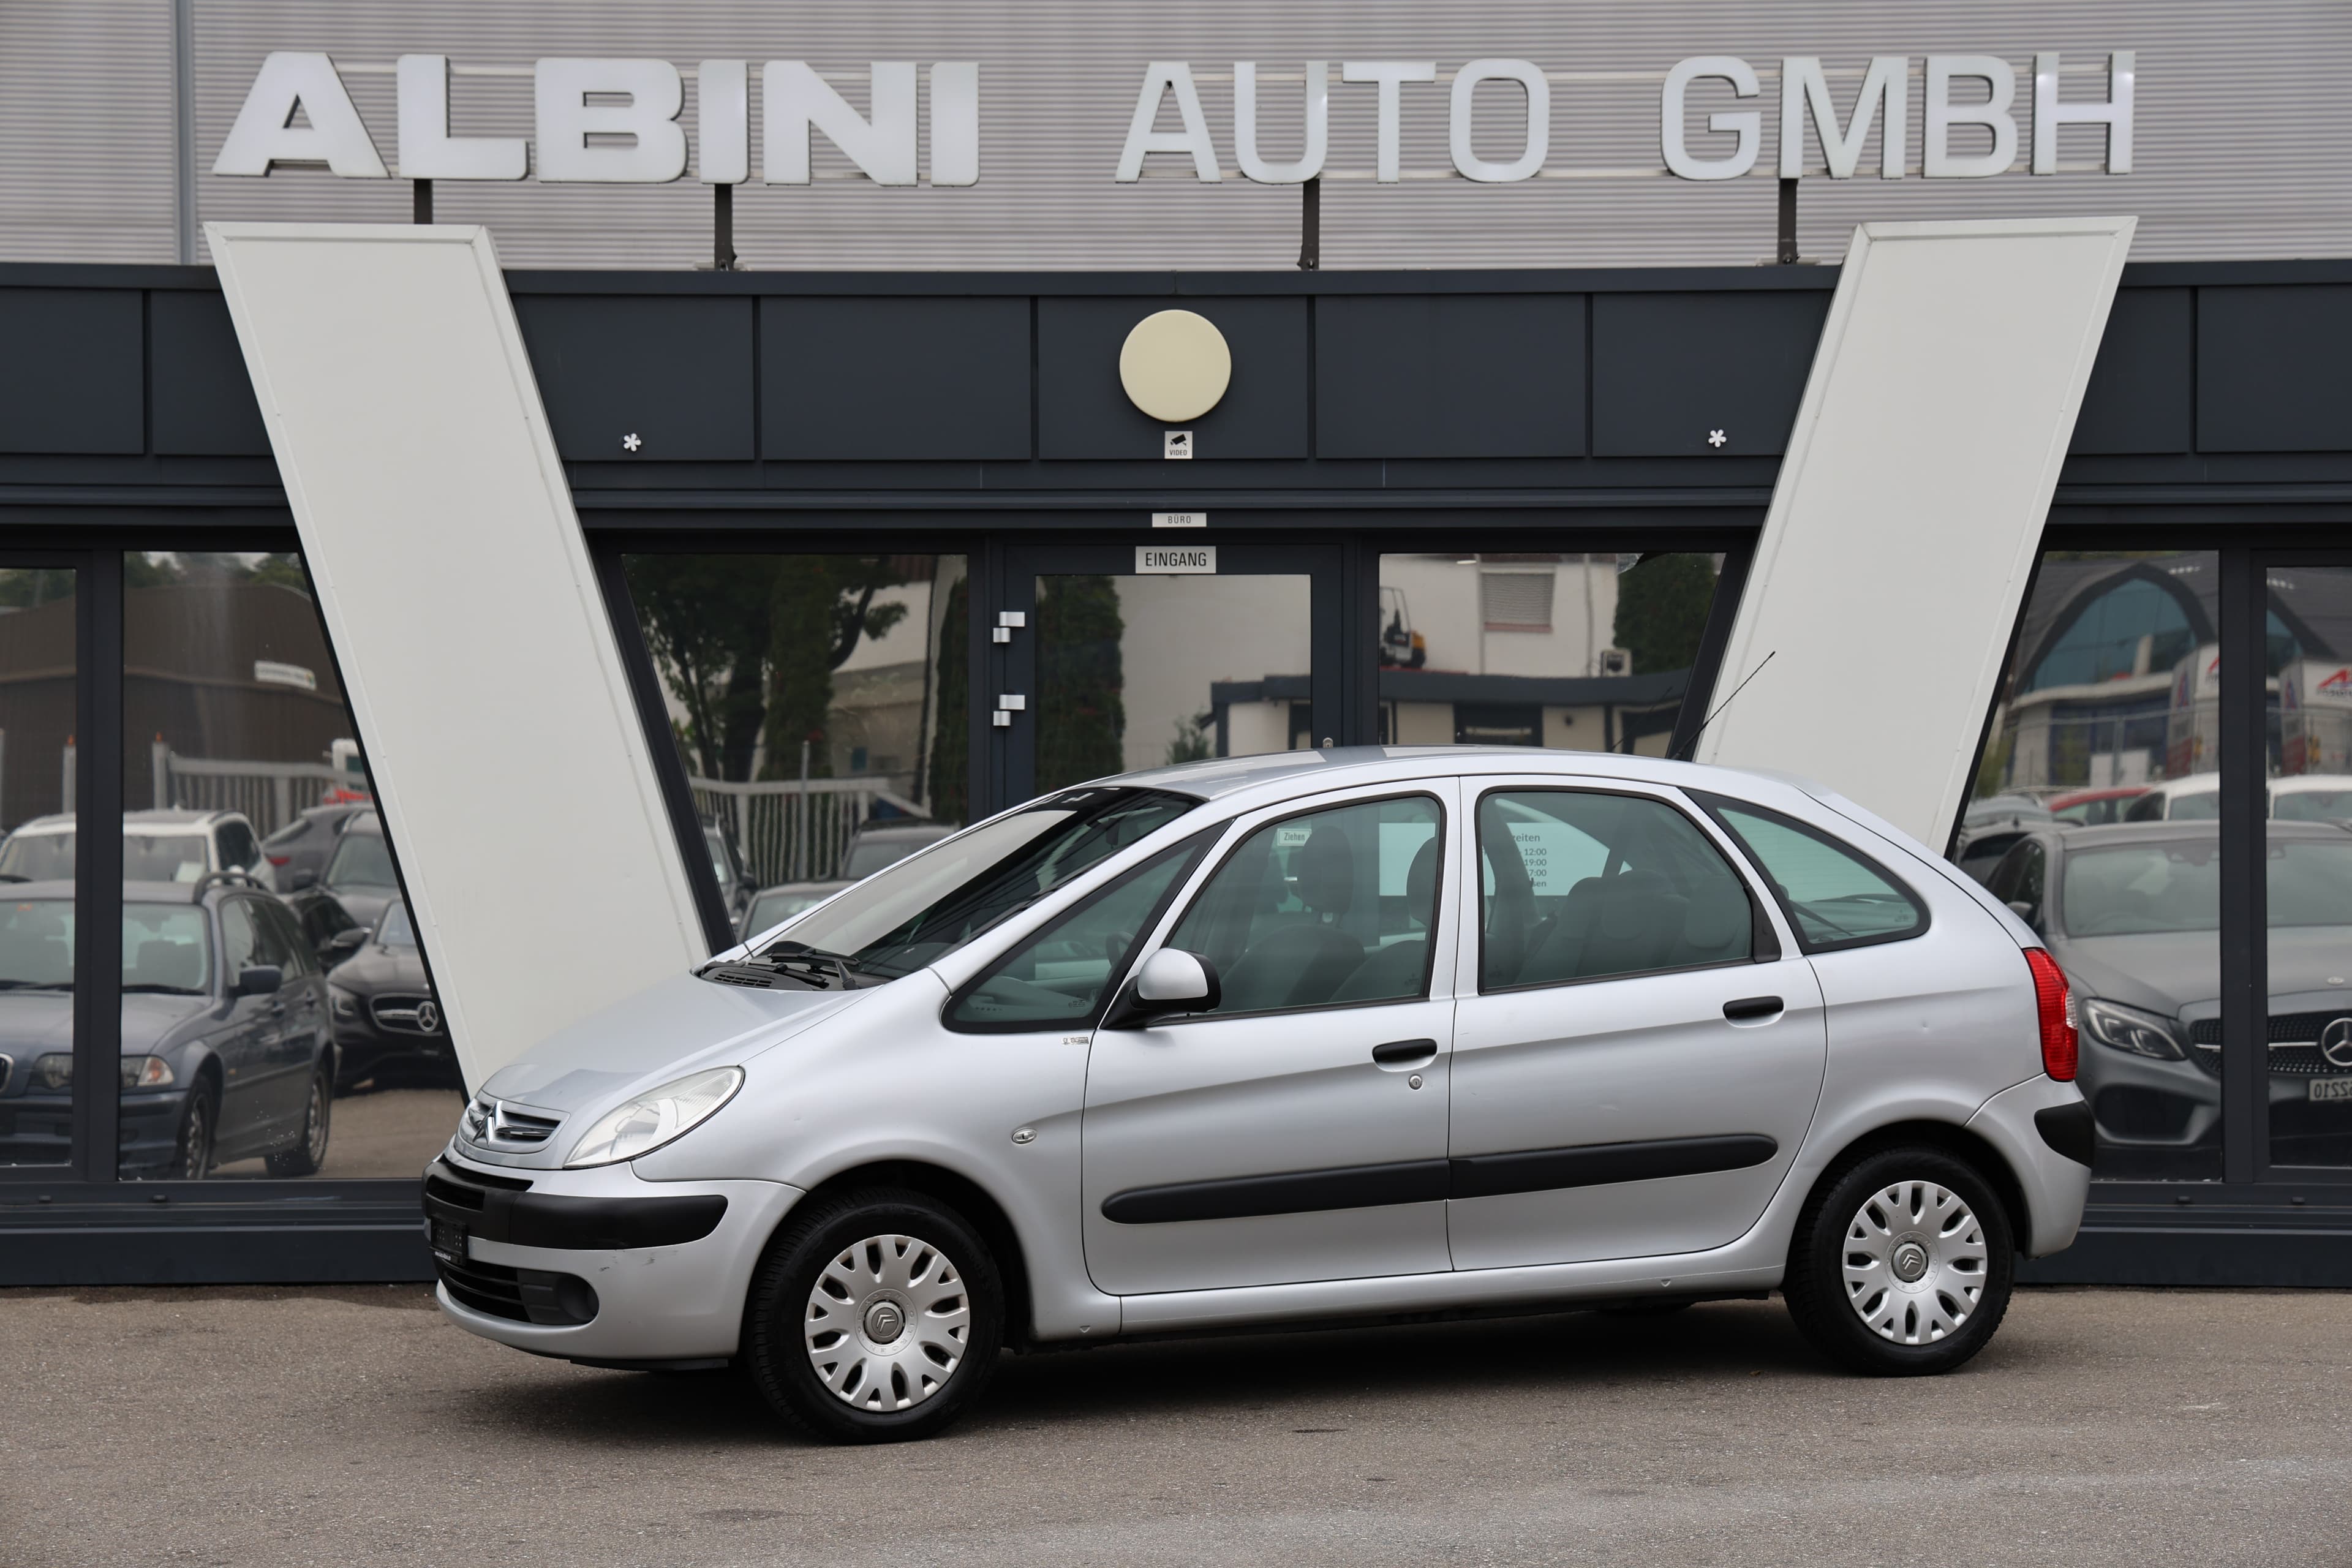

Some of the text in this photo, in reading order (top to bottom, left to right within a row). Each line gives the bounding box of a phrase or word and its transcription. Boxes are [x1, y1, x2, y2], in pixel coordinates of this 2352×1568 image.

[212, 51, 2136, 187] ALBINI AUTO GMBH
[1167, 514, 1191, 524] BÜRO
[1145, 552, 1207, 567] EINGANG
